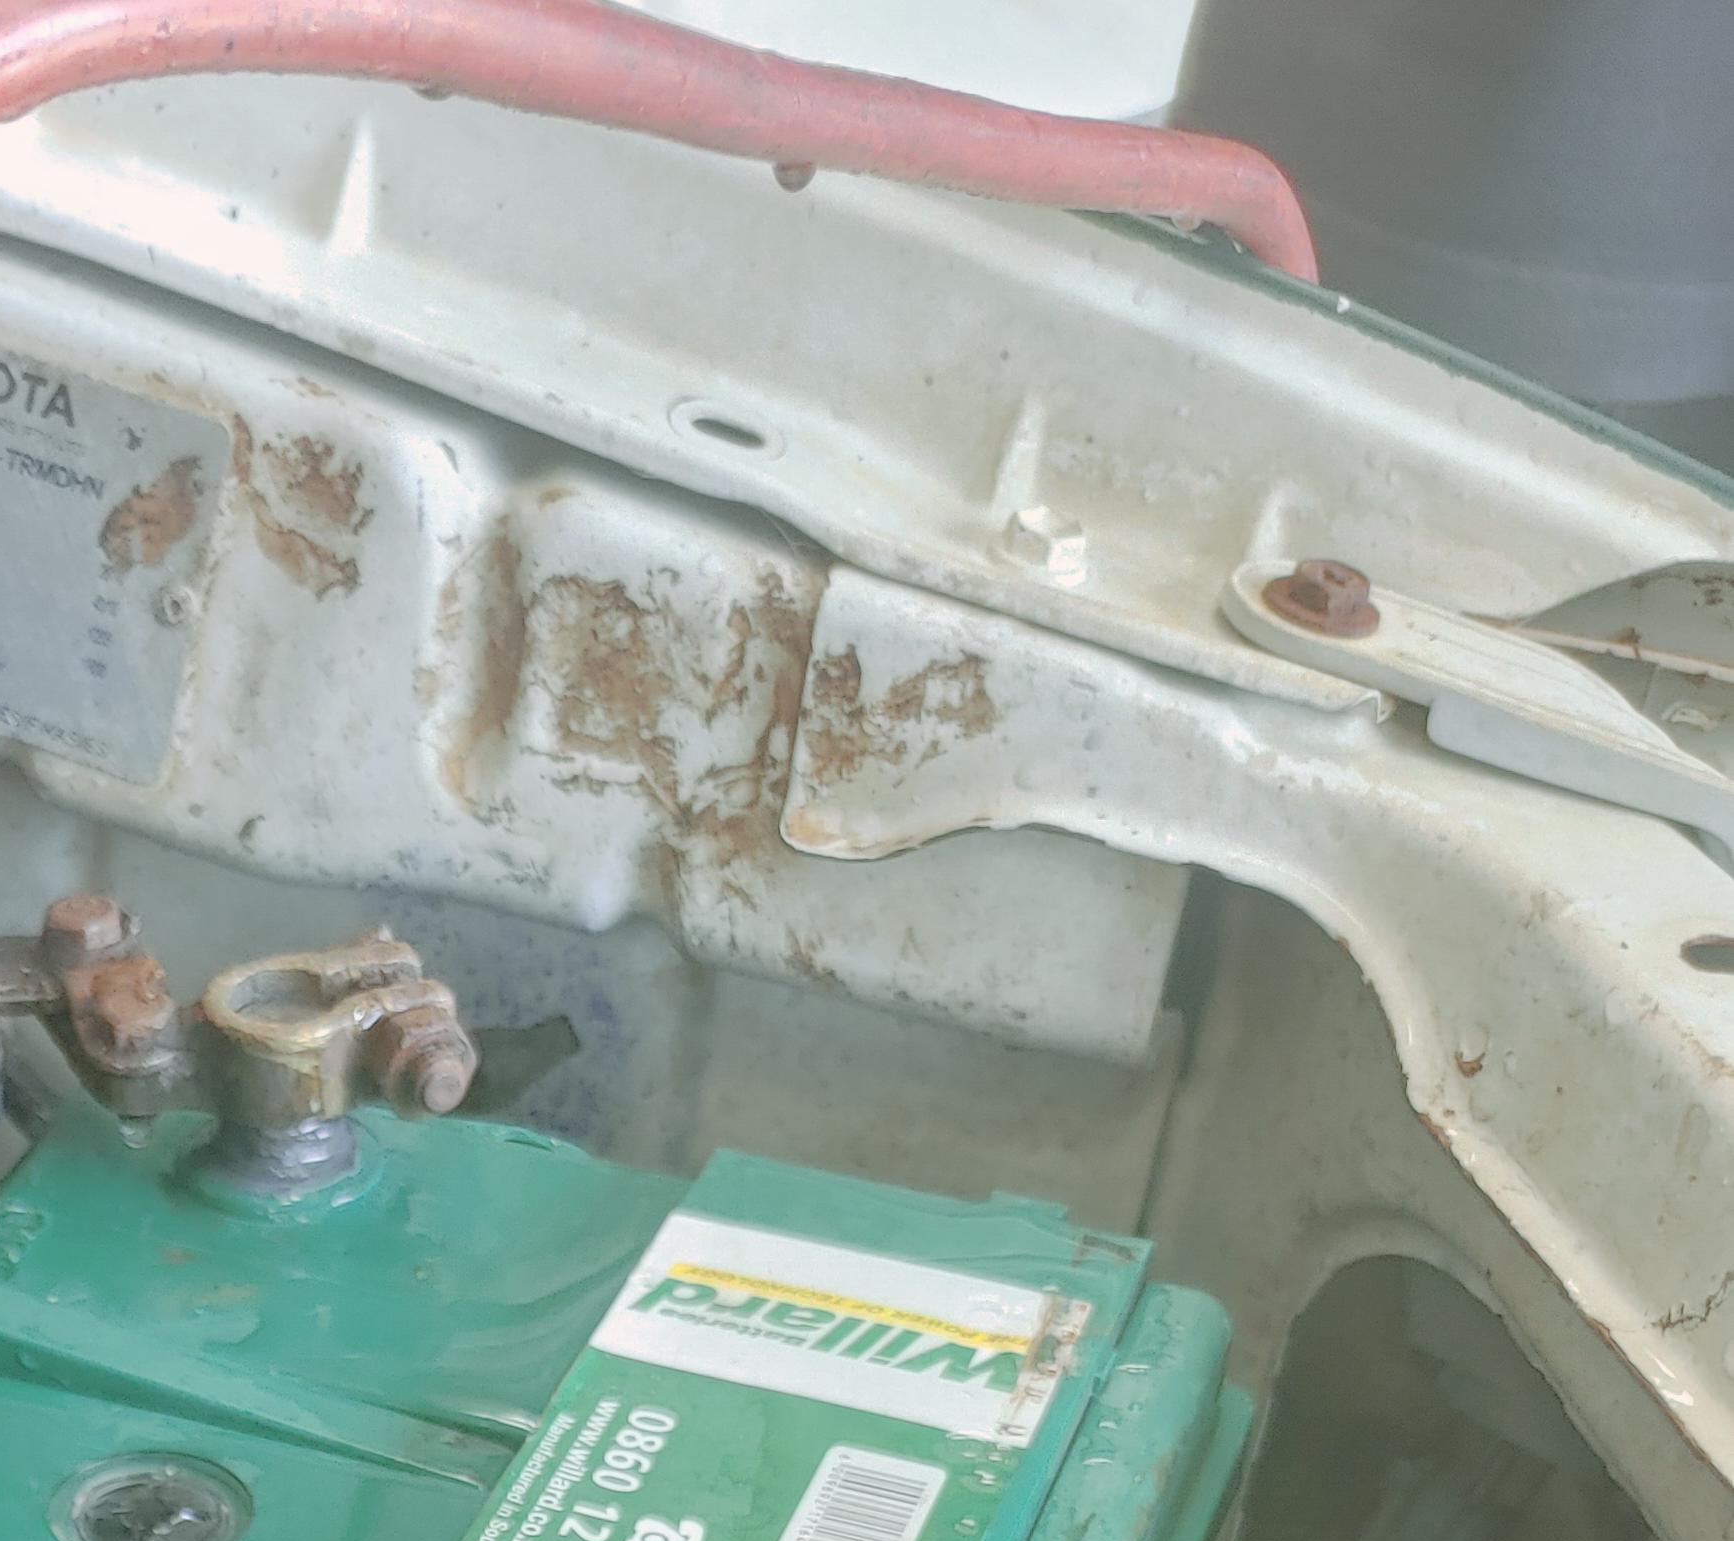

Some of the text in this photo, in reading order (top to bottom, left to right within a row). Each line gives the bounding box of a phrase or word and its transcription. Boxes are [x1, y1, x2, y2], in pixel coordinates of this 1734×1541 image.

[628, 1277, 1027, 1393] Willard
[659, 1308, 807, 1346] Batteries
[506, 1412, 576, 1505] Manufactured
[591, 1405, 676, 1493] 0860
[496, 1503, 520, 1518] in
